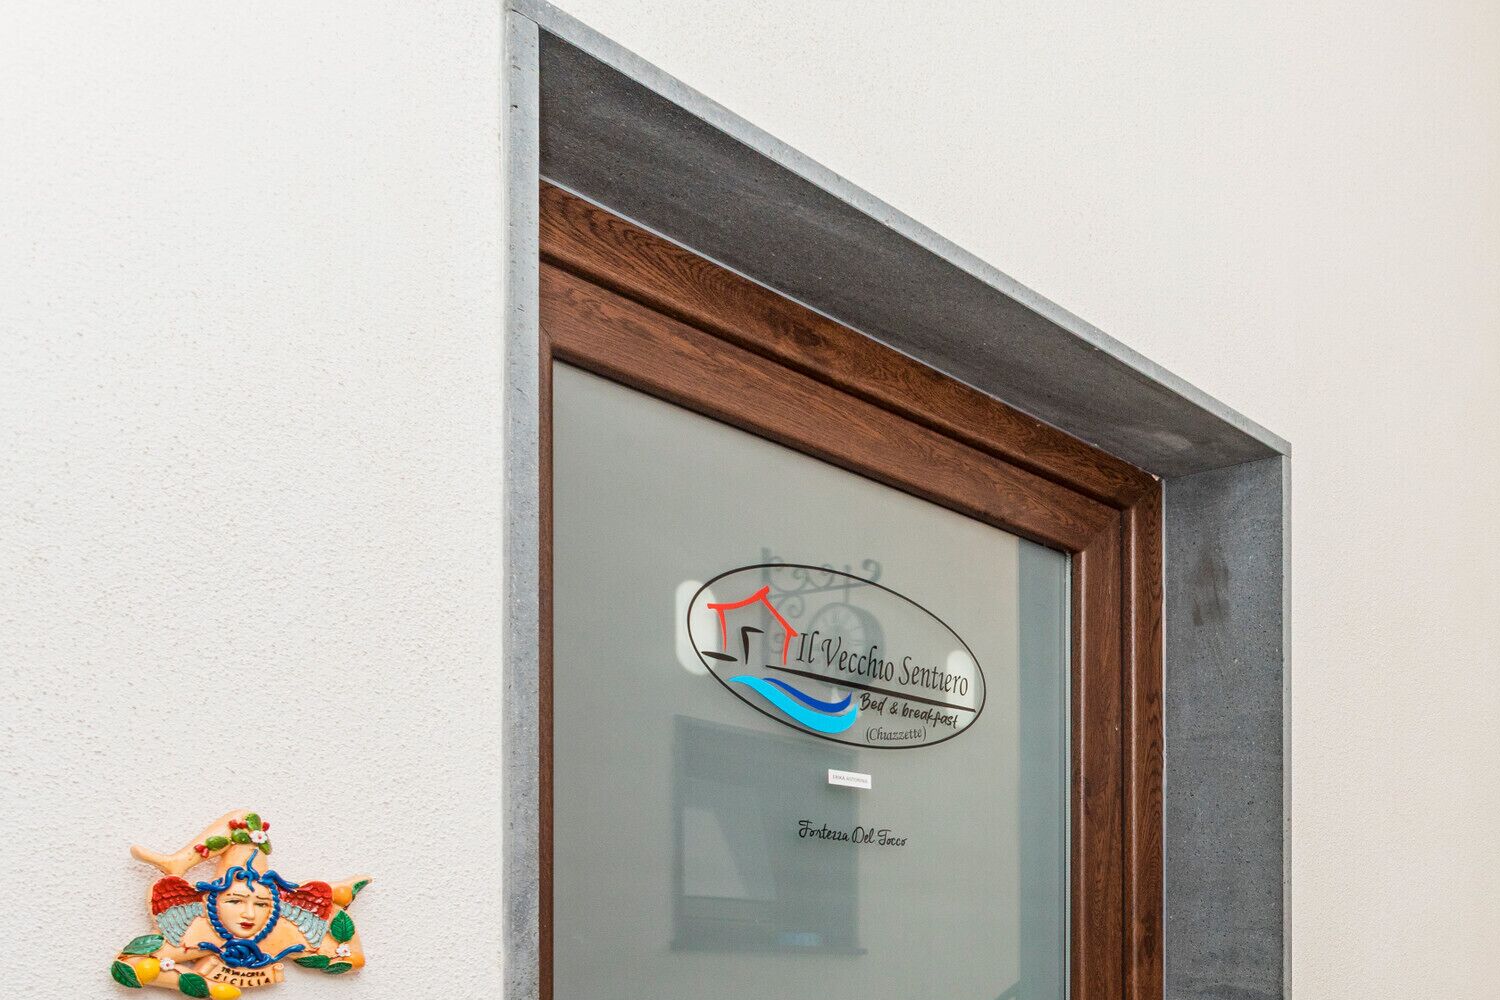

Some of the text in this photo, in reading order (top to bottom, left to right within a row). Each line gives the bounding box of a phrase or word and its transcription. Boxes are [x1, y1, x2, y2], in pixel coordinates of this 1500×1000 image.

[796, 630, 969, 697] Il Vecchio Sentiero
[859, 692, 958, 730] Bed & breakfast
[213, 973, 271, 987] SICILIA
